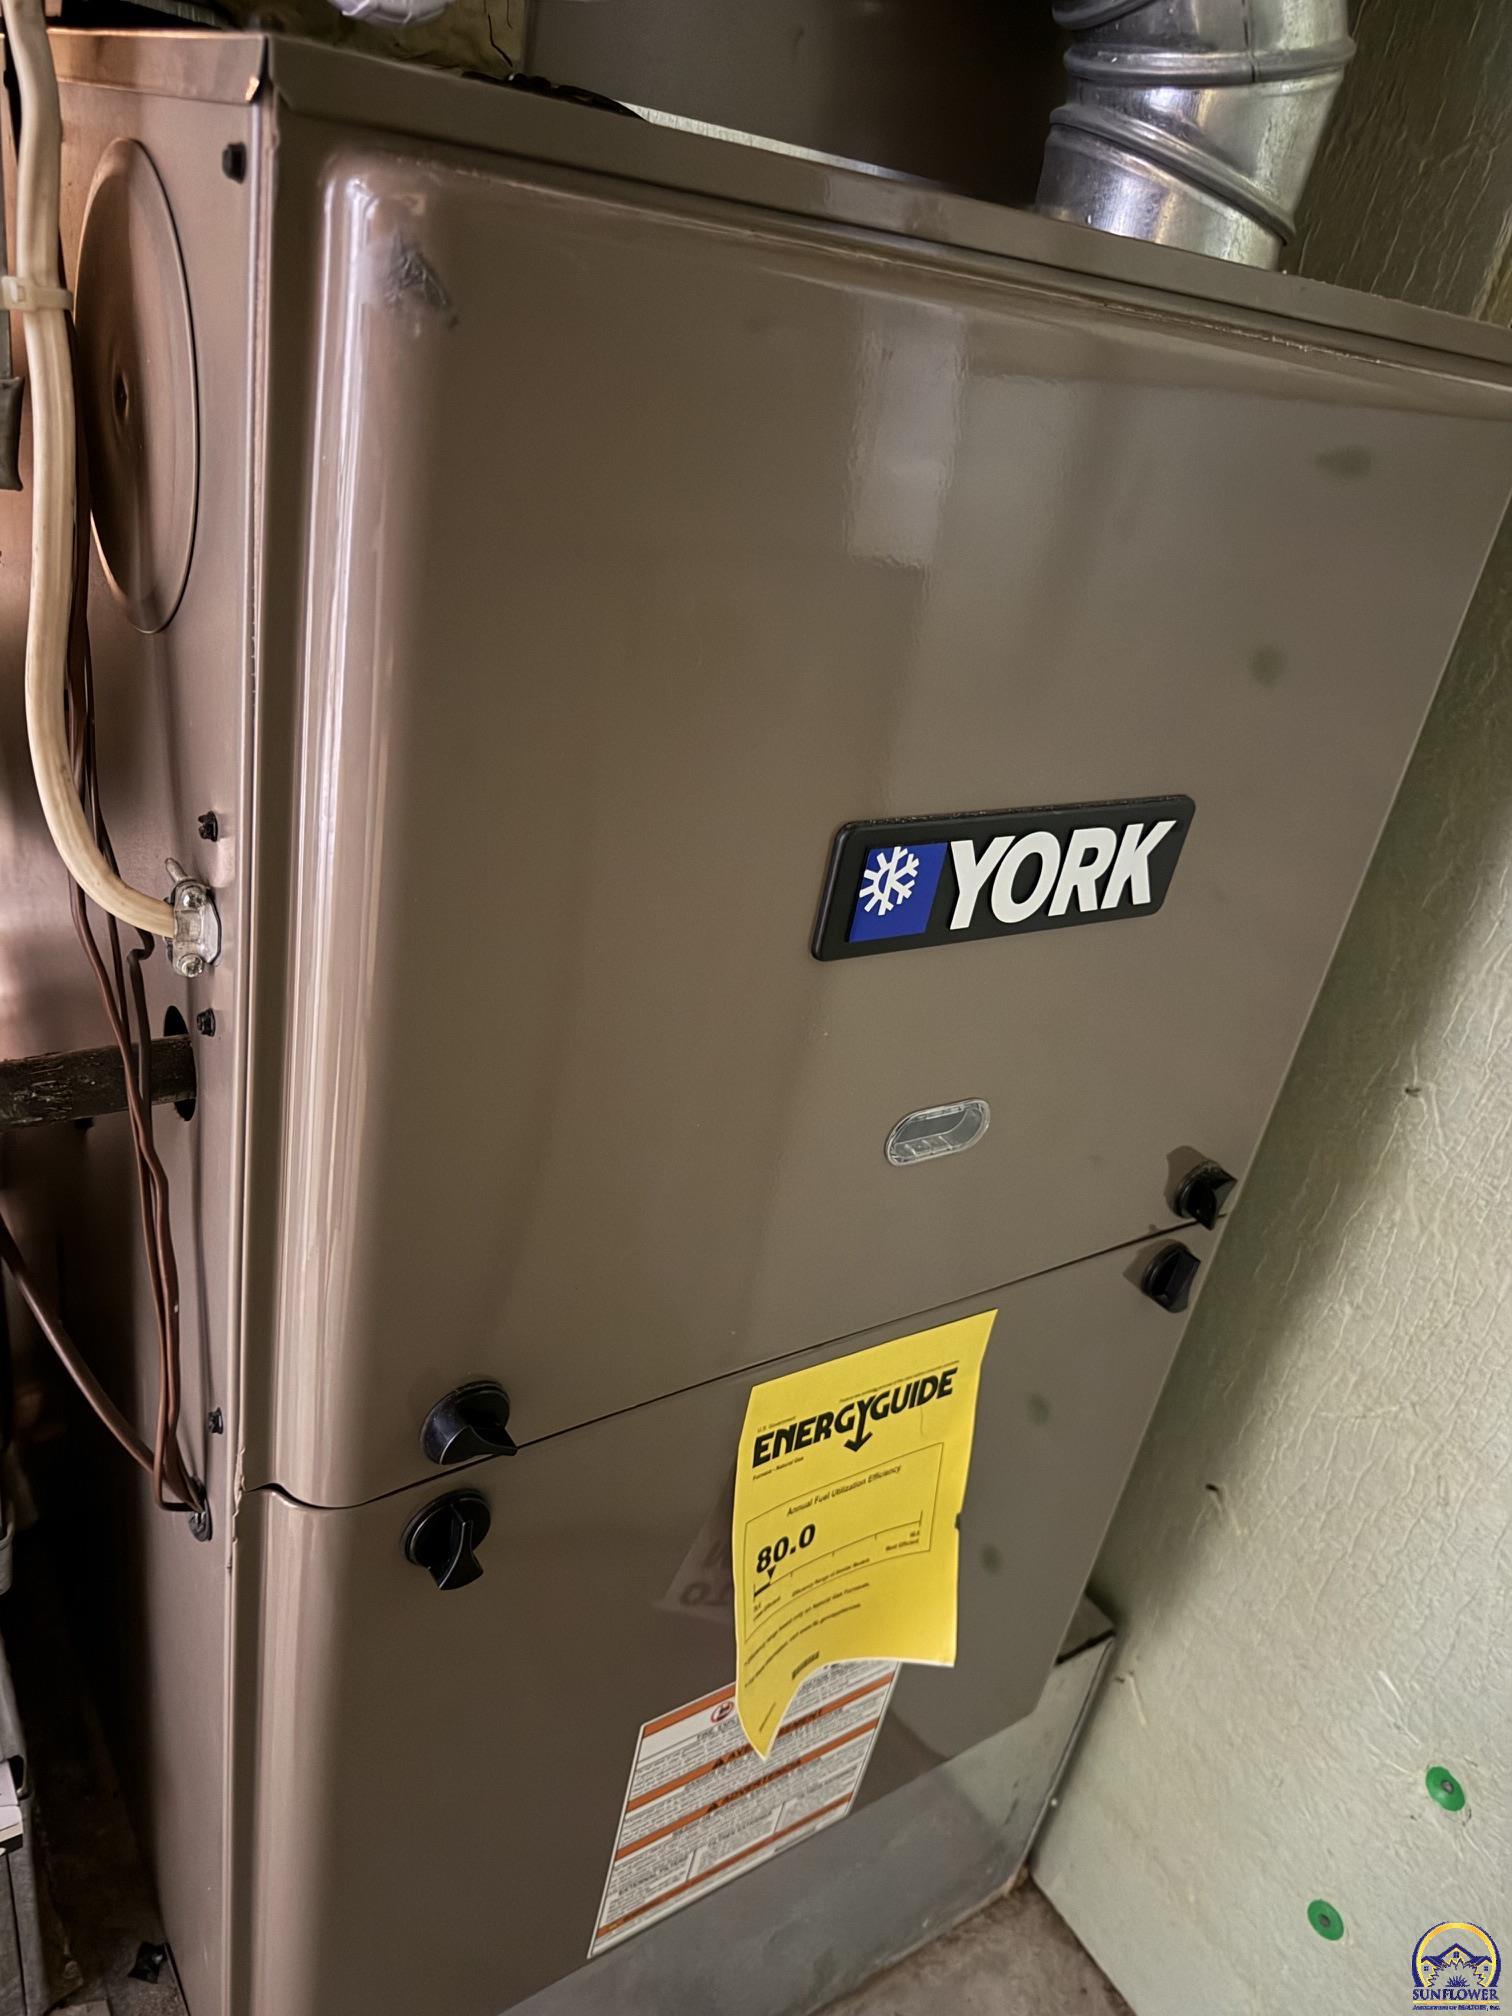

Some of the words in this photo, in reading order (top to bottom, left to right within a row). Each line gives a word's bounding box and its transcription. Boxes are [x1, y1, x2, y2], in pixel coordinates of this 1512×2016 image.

[950, 820, 1176, 930] YORK
[752, 1367, 958, 1468] ENERGYGUIDE
[787, 1499, 813, 1516] Annual
[814, 1491, 830, 1504] Fuel
[756, 1524, 815, 1574] 80.0
